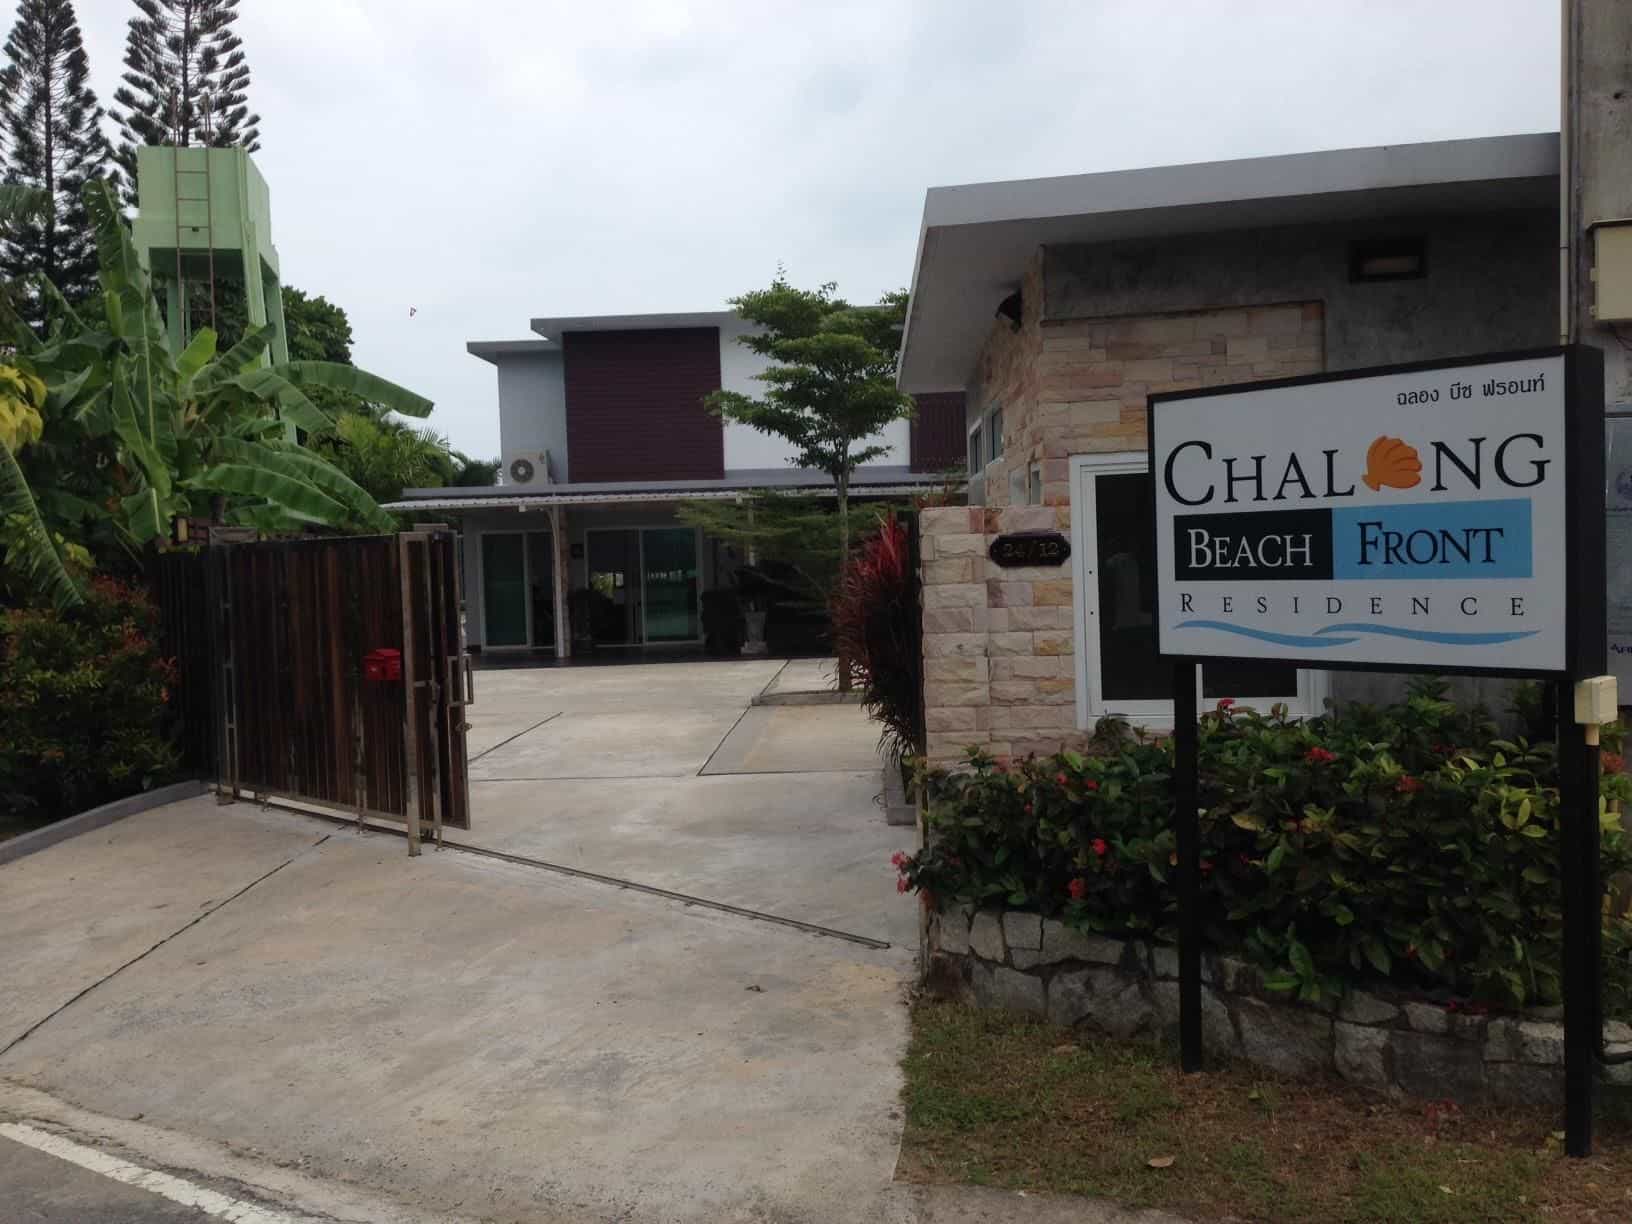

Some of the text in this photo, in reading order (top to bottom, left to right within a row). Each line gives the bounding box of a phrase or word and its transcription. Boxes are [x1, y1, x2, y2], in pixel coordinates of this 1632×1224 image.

[1187, 521, 1504, 569] BEACH FRONT
[1180, 593, 1525, 617] RESIDENCE
